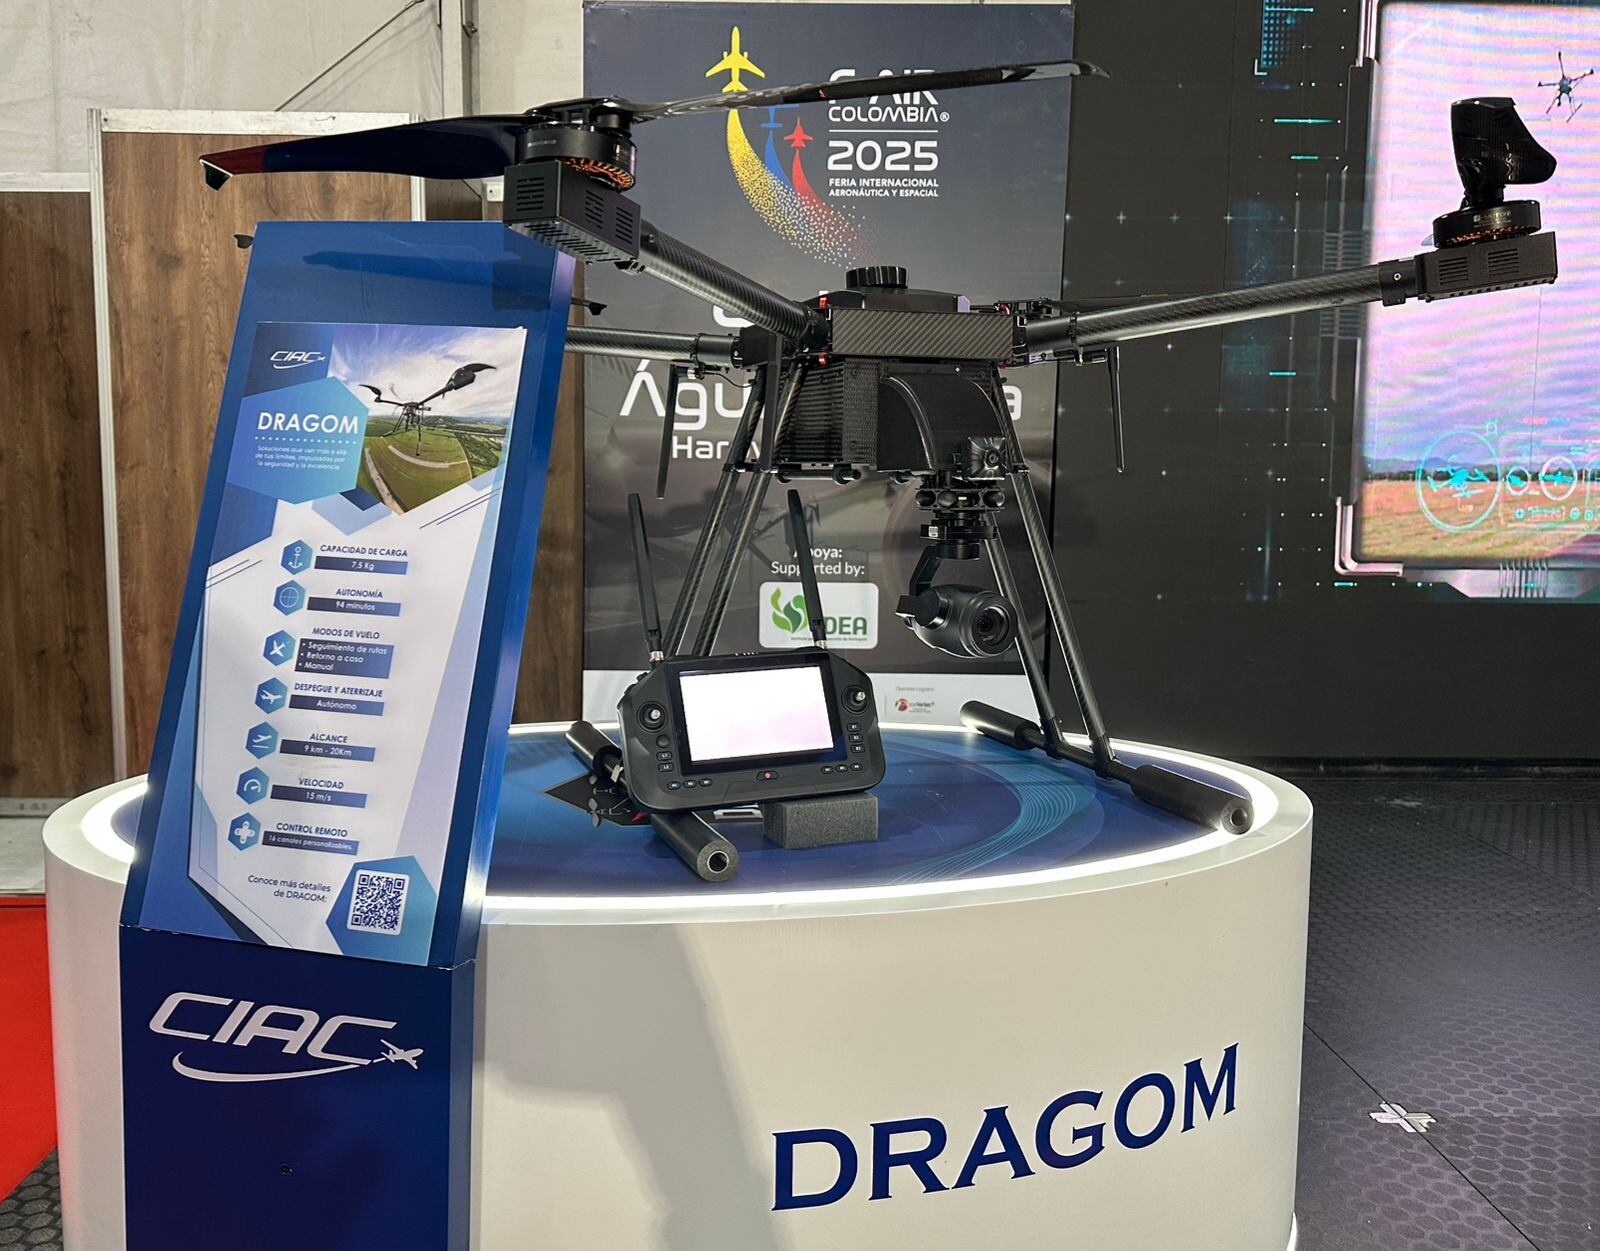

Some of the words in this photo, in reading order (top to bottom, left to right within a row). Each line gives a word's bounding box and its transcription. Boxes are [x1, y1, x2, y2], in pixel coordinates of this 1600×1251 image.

[828, 141, 938, 171] 2025
[829, 179, 856, 187] FERIA
[859, 179, 938, 187] INTERNACIONAL
[829, 188, 889, 197] AERONÁUTICA
[891, 189, 897, 197] Y
[899, 189, 938, 197] ESPACIAL
[270, 351, 321, 361] CIAC
[258, 412, 358, 434] DRAGOM
[264, 461, 295, 469] seguridad
[320, 545, 366, 555] CAPACIDAD
[368, 548, 378, 556] DE
[380, 549, 408, 557] CARGA
[365, 562, 375, 571] Kg
[844, 562, 865, 577] by:
[336, 588, 383, 598] AUTONOMÍA
[346, 602, 375, 611] minutos
[312, 627, 342, 637] MODOS
[344, 630, 354, 638] DE
[356, 631, 380, 640] VUELO
[308, 641, 355, 653] Seguimiento
[356, 645, 367, 653] de
[368, 647, 387, 655] rutas
[306, 651, 336, 661] Retorno
[344, 655, 364, 663] casa
[303, 661, 334, 671] Manual
[294, 683, 332, 693] DESPEGUE
[340, 688, 383, 698] ATERRIZAJE
[316, 700, 357, 710] Autónomo
[309, 733, 348, 743] ALCANCE
[310, 745, 323, 753] km
[330, 747, 352, 757] 20Km
[299, 778, 344, 789] VELOCIDAD
[306, 792, 314, 800] 15
[315, 793, 332, 802] m/s
[276, 823, 313, 834] CONTROL
[315, 827, 348, 837] REMOTO
[269, 834, 276, 842] 16
[276, 836, 302, 845] canales
[248, 875, 279, 886] Conoce
[280, 878, 297, 888] más
[298, 881, 331, 893] detalles
[273, 889, 284, 898] de
[286, 891, 327, 903] DRAGOM:
[149, 991, 397, 1066] CIAC
[770, 1042, 1239, 1211] DRAGOM
